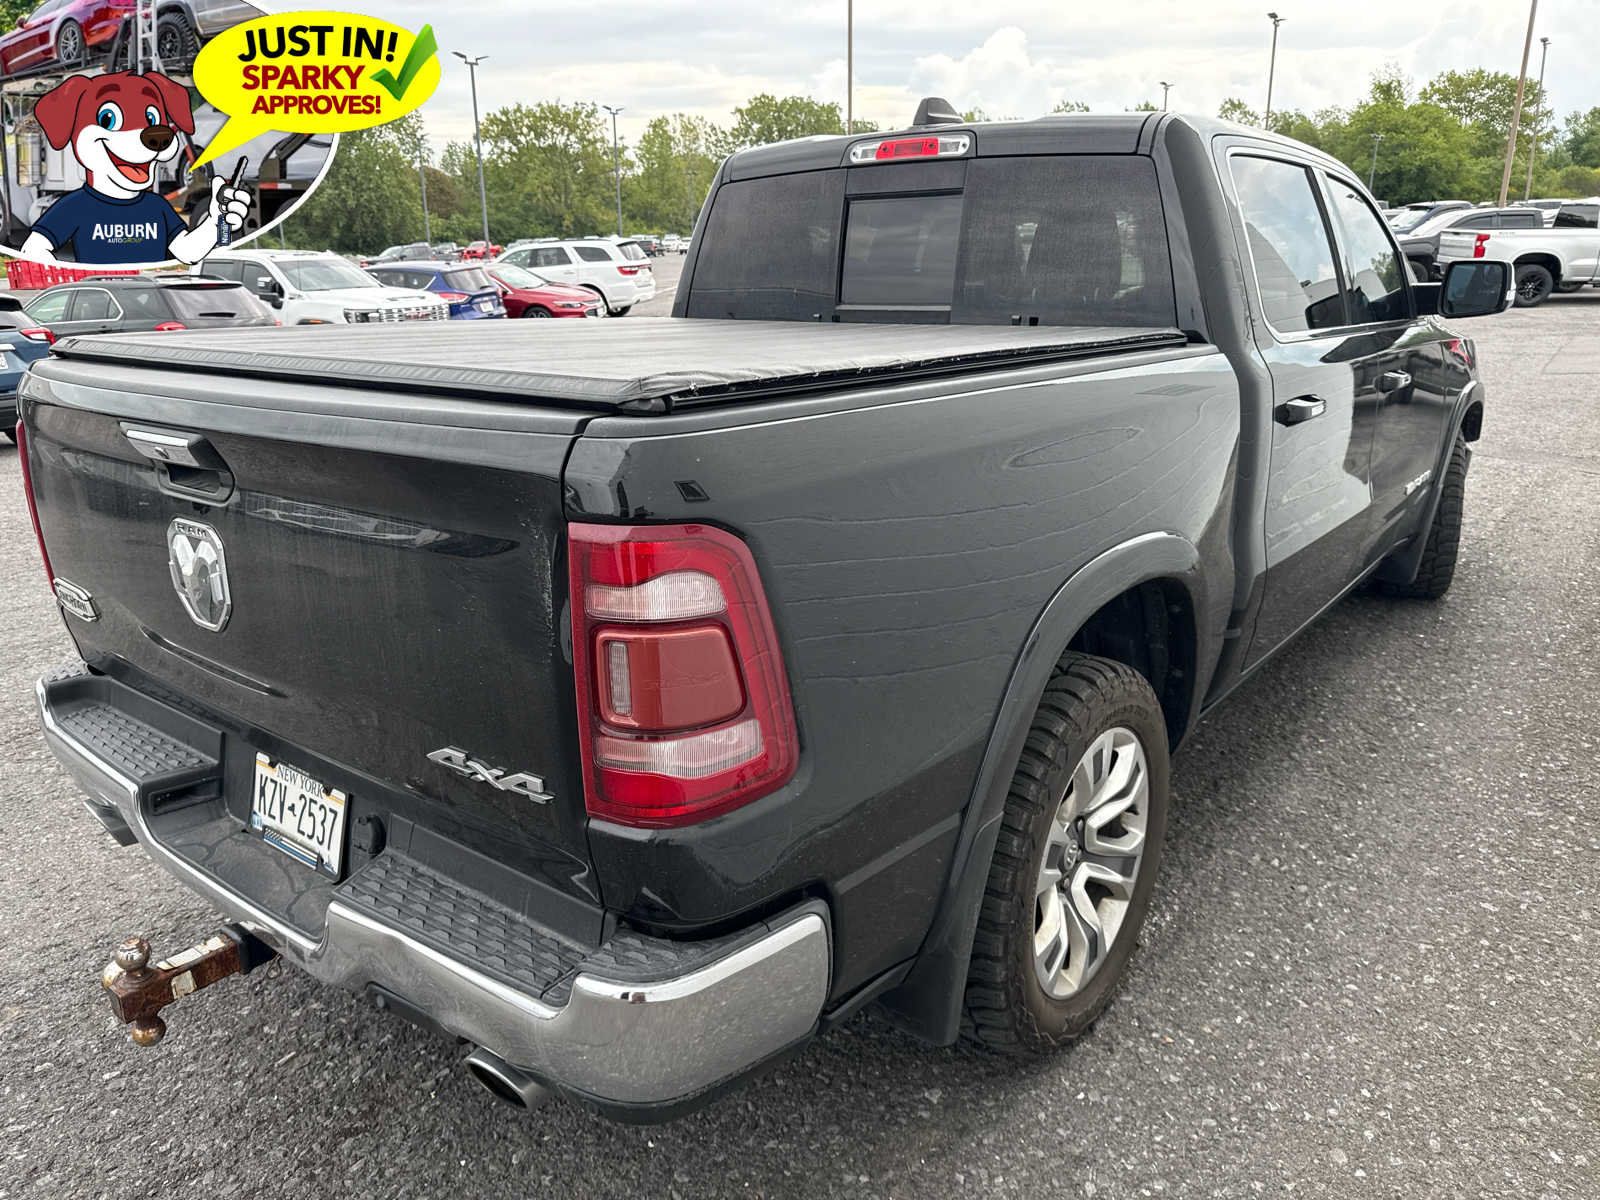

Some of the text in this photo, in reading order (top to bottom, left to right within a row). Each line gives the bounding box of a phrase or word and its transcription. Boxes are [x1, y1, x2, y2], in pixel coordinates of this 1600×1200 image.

[175, 522, 207, 537] RAM
[277, 765, 298, 786] NEW
[300, 776, 324, 800] YORK
